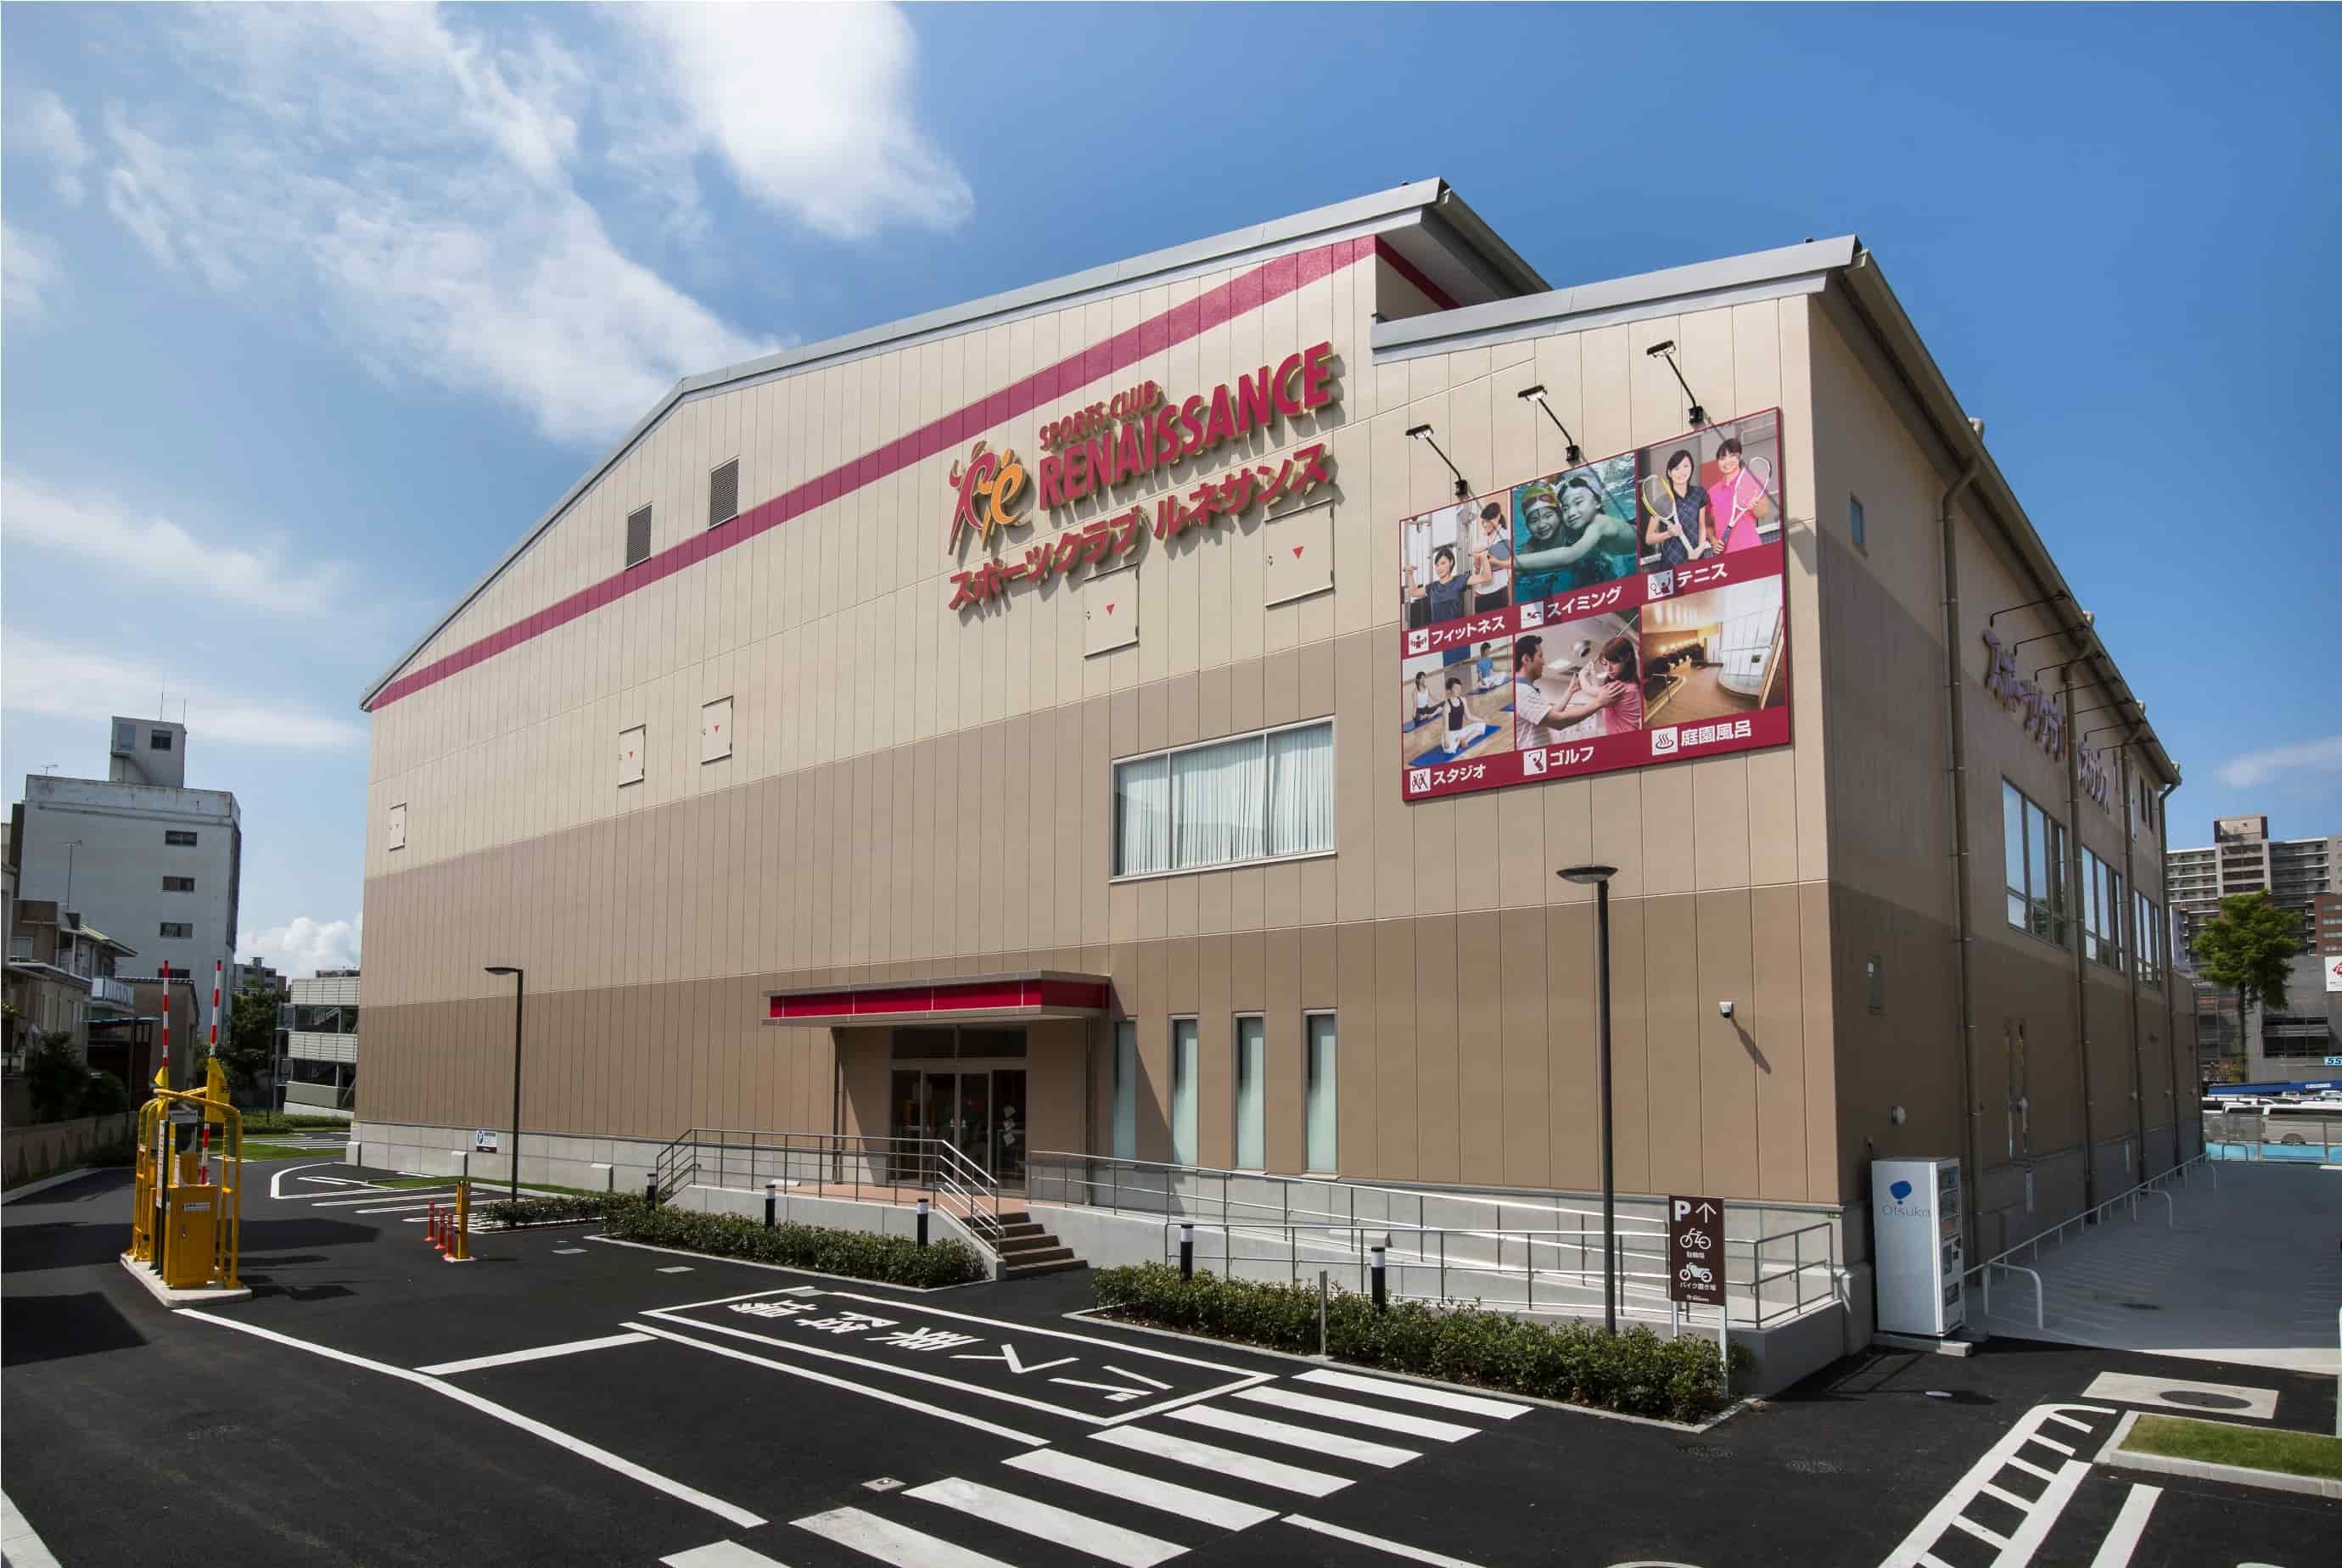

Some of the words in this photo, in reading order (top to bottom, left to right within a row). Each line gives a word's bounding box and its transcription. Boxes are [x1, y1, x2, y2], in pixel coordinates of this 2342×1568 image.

[1039, 402, 1105, 451] SPORTS
[1109, 380, 1159, 417] CLUB
[1039, 342, 1334, 510] RENAISSANCE
[950, 507, 1141, 610] スポーツクラブ
[1155, 444, 1331, 540] ルネサンス
[1677, 564, 1727, 589] テニス
[1548, 587, 1622, 619] スイミング
[1432, 617, 1505, 645] フィットネス
[1681, 720, 1751, 748] 庭園風呂
[1550, 747, 1595, 766] ゴルフ
[1432, 764, 1486, 785] スタジオ
[1674, 1201, 1691, 1222] P
